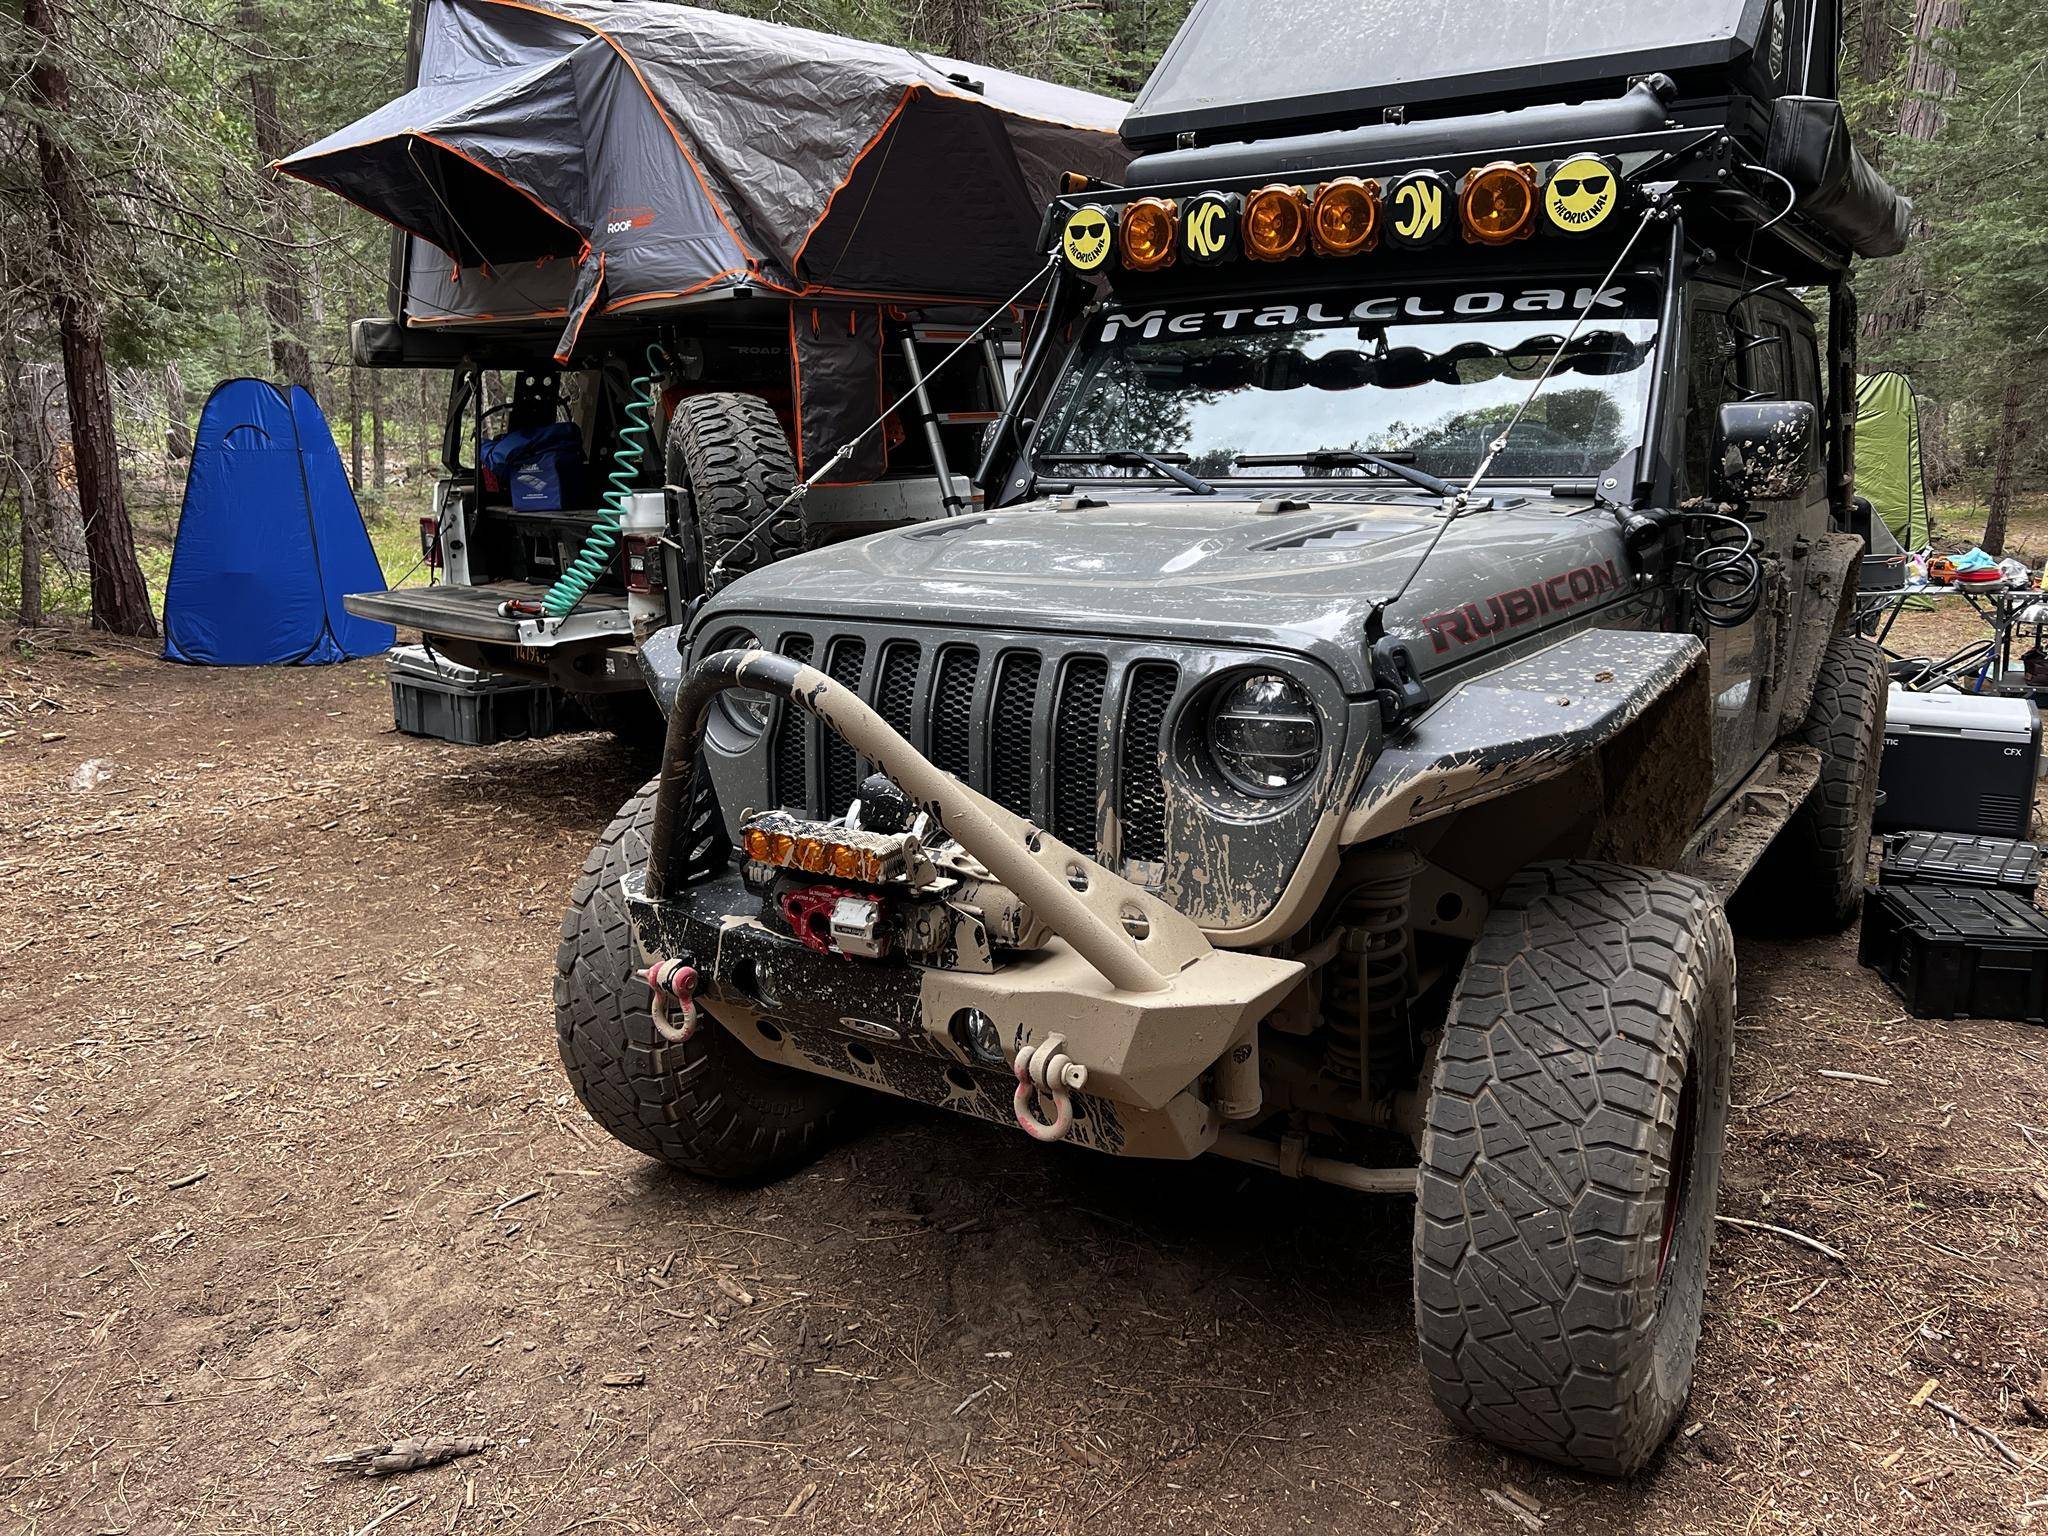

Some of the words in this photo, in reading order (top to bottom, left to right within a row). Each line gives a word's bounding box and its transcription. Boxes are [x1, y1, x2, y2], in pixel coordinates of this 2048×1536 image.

[607, 219, 632, 234] ROOF
[1187, 201, 1226, 256] KC
[1395, 181, 1442, 239] KC
[1100, 286, 1627, 343] METALCLOAK
[1421, 559, 1623, 654] RUBICON
[2003, 747, 2022, 756] CFX
